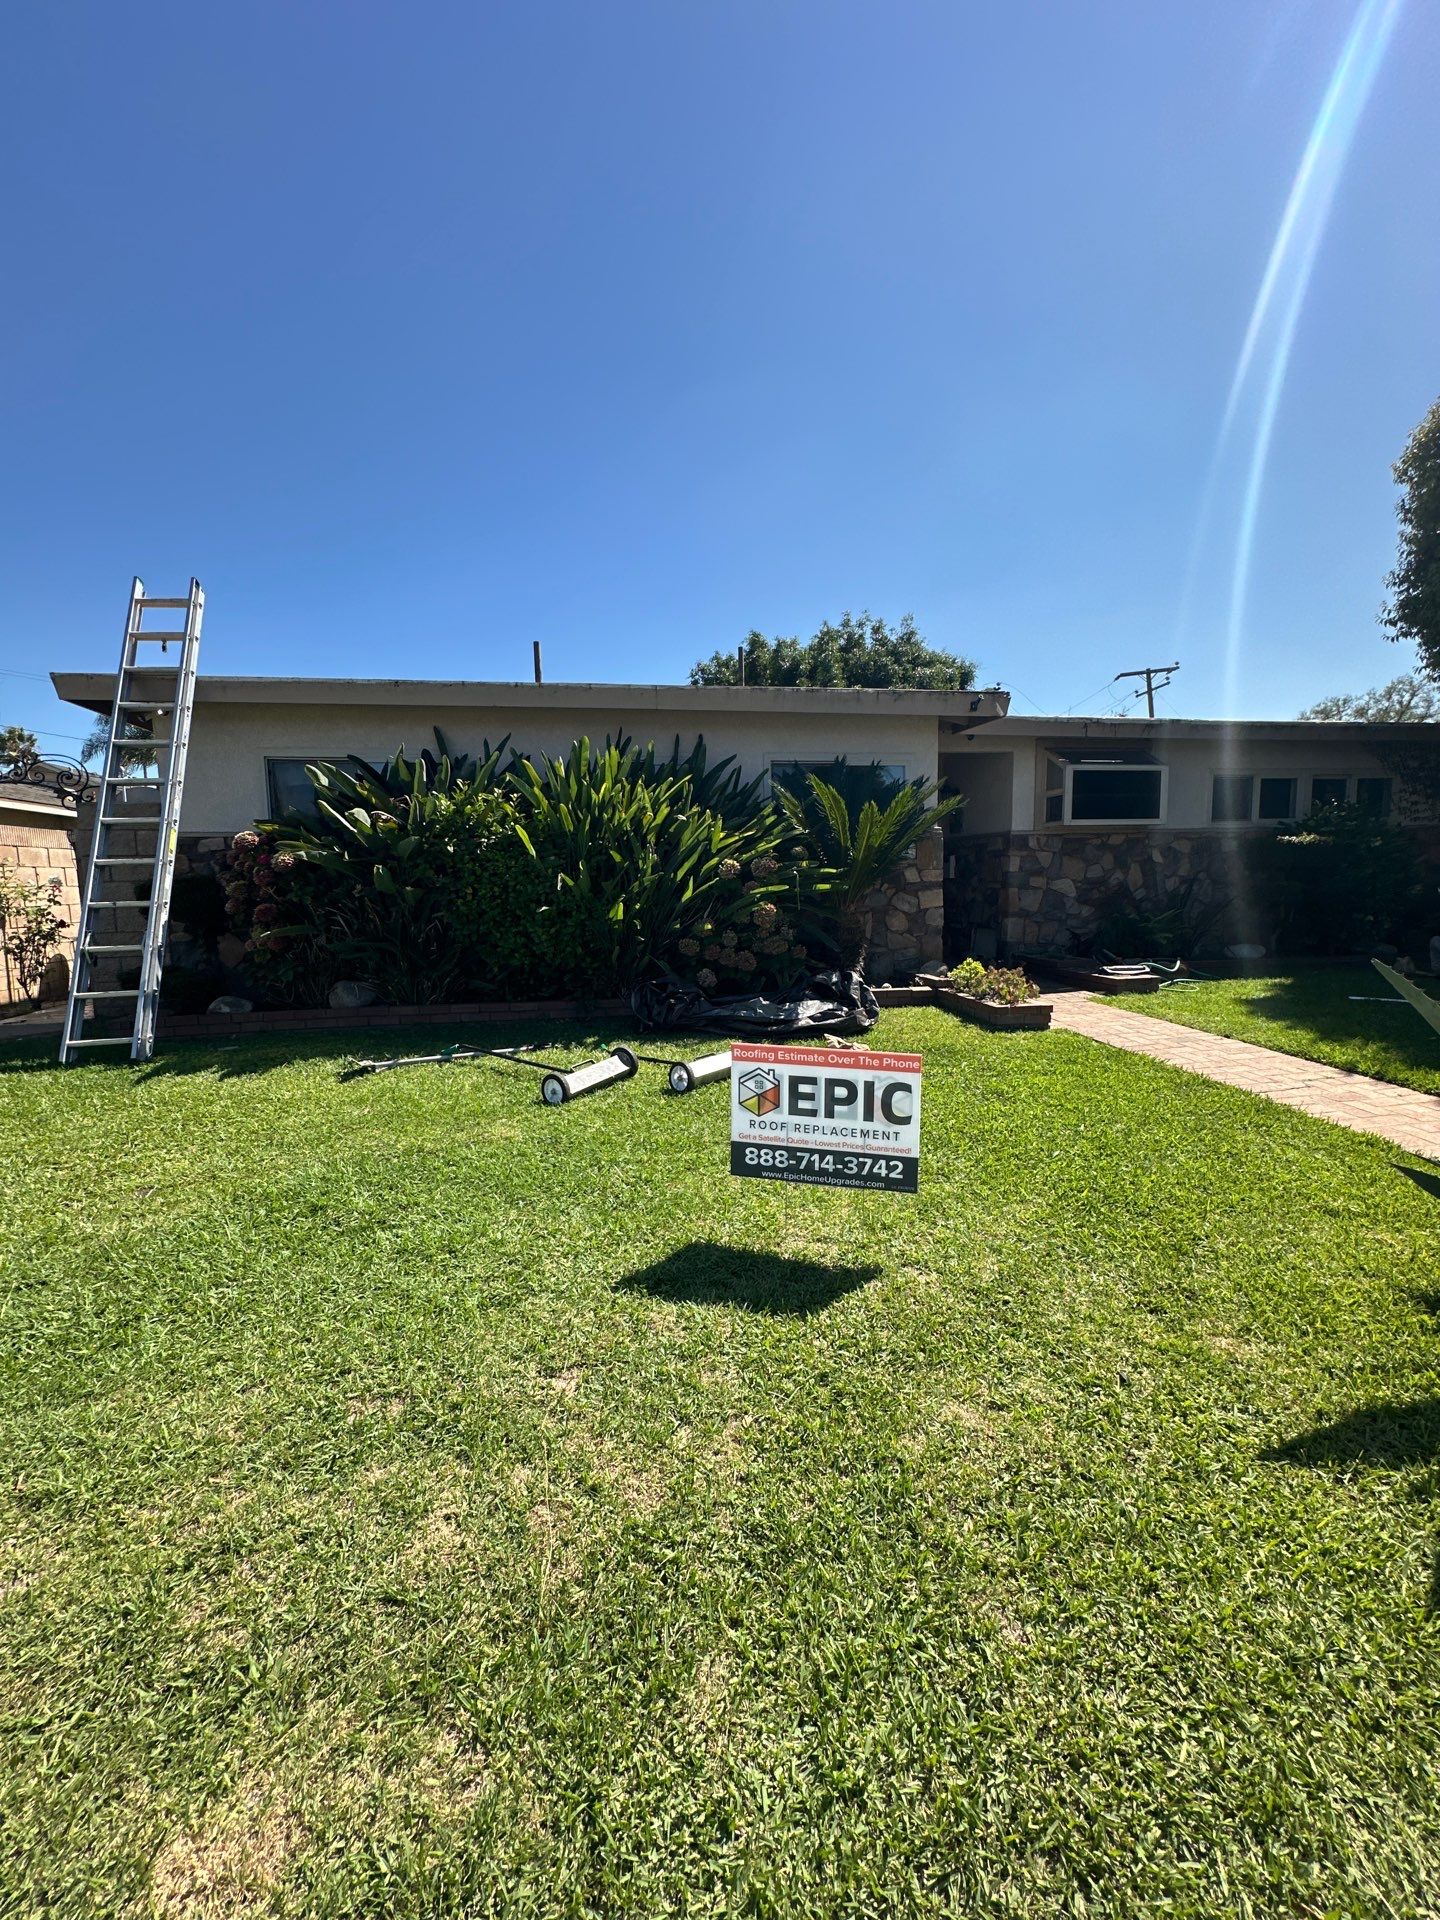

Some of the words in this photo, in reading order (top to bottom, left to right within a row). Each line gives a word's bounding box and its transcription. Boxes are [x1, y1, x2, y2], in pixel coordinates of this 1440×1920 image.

[734, 1048, 775, 1061] Roofing
[778, 1051, 825, 1063] Estimate
[829, 1055, 855, 1065] Over
[859, 1057, 879, 1066] The
[884, 1058, 920, 1069] Phone
[788, 1075, 912, 1125] EPIC
[750, 1120, 787, 1131] ROOF
[795, 1124, 900, 1141] REPLACEMENT
[758, 1134, 785, 1143] Satellite
[787, 1137, 809, 1145] Quote
[815, 1140, 841, 1148] Lowest
[842, 1142, 864, 1150] Prices
[866, 1144, 912, 1154] Guaranteed!
[745, 1147, 903, 1179] 888-714-3742
[762, 1171, 884, 1188] www.EpicHomeUpgrades.com
